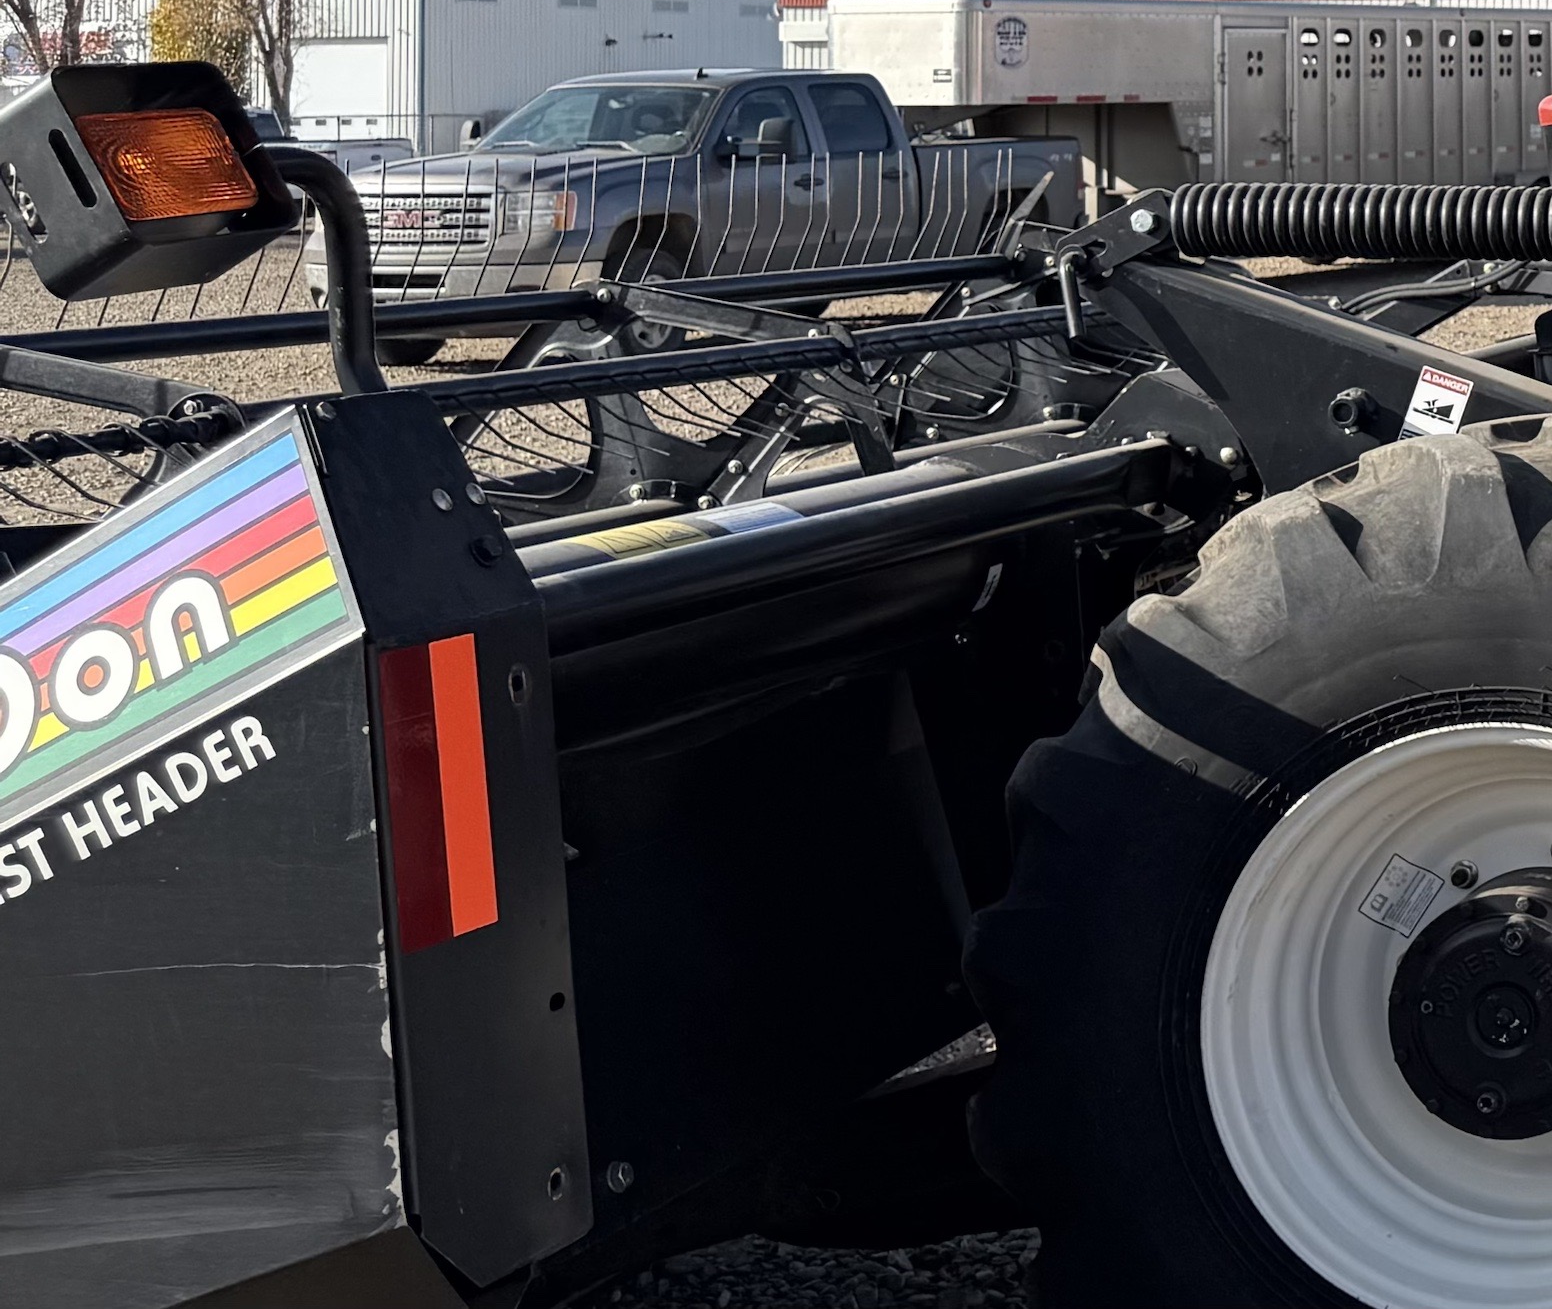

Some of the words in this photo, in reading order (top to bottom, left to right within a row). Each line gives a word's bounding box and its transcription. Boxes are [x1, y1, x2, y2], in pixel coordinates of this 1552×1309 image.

[1431, 374, 1469, 394] DANGER
[0, 827, 54, 903] ST
[61, 715, 277, 861] HEADER
